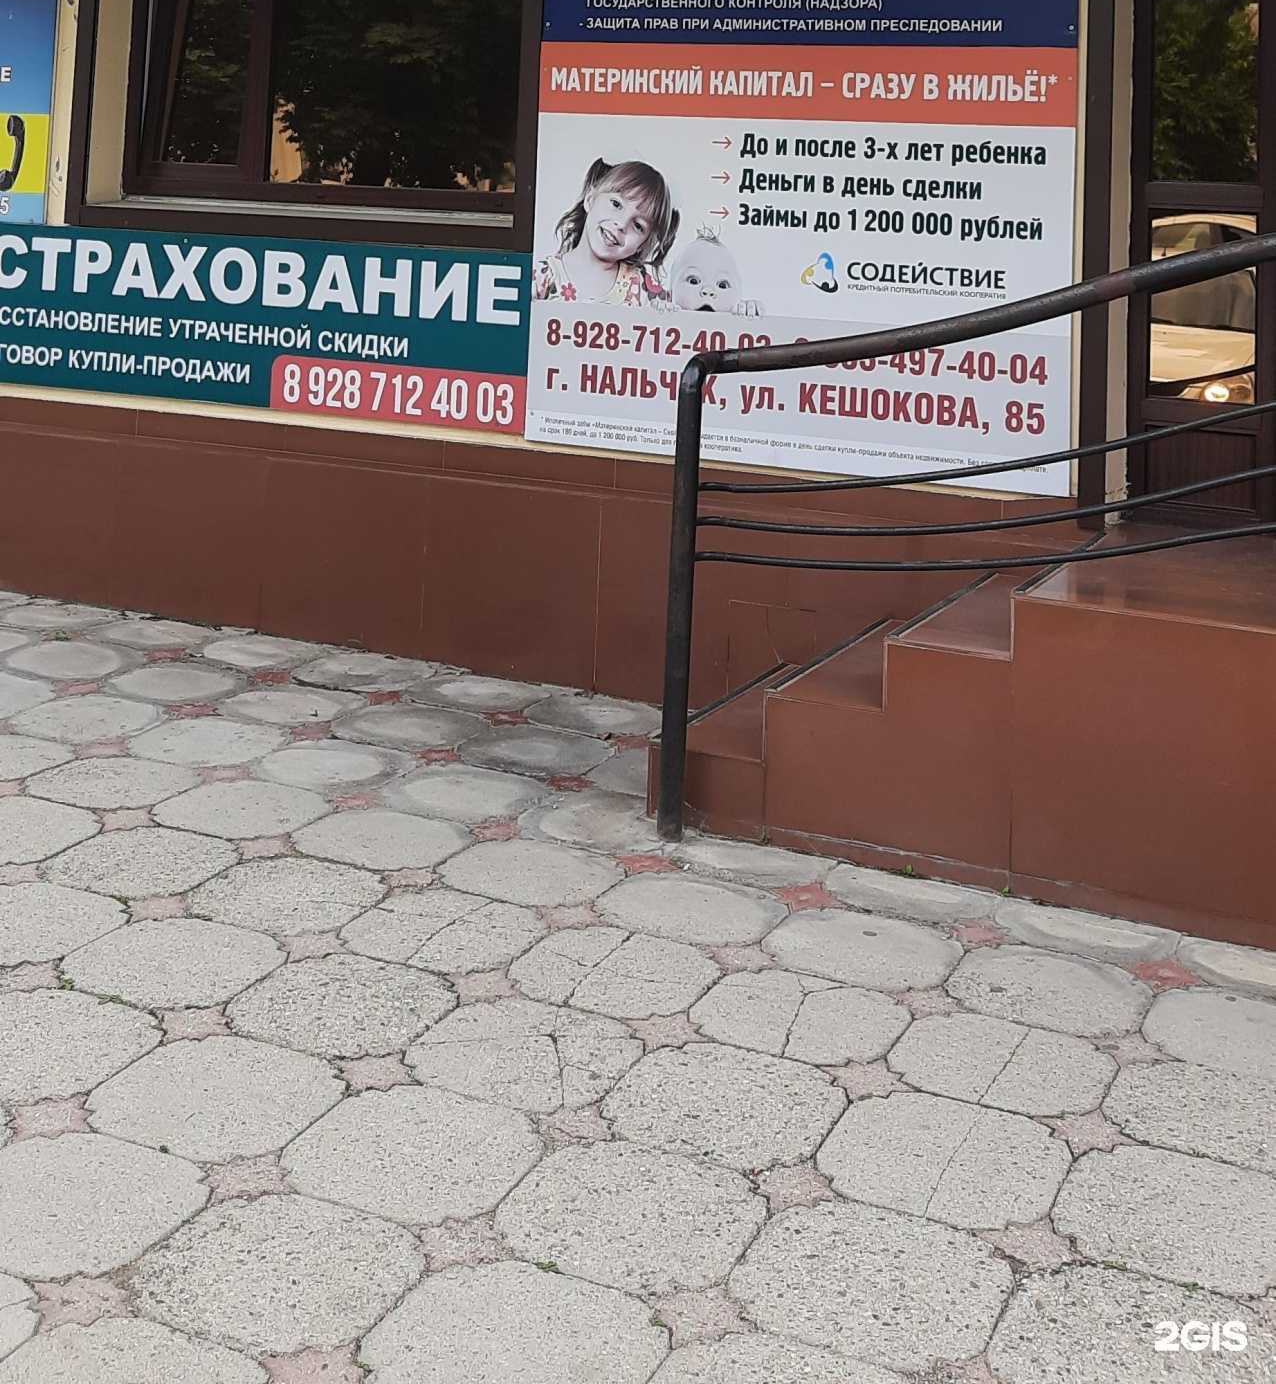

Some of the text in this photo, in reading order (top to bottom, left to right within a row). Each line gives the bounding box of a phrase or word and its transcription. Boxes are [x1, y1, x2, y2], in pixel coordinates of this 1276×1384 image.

[586, 18, 640, 31] ЗАЩИТА
[644, 18, 678, 30] ПРАВ
[682, 18, 709, 30] ПРИ
[713, 18, 866, 32] АДМИНИСТРАТИВНОМ
[870, 19, 1002, 33] ПРЕСЛЕДОВАНИИ
[551, 66, 703, 94] МАТЕРИНСКИЙ
[709, 70, 813, 97] КАПИТАЛ
[842, 73, 916, 100] СРАЗУ
[923, 74, 939, 100] В
[740, 134, 1046, 166] До и после 3-х лет ребенка
[738, 169, 982, 200] Деньги в день сделки
[738, 204, 1043, 241] Займы до 1 200 000 рублей
[0, 234, 522, 326] СТРАХОВАНИЕ
[846, 261, 1007, 289] СОДЕЙСТВИЕ
[848, 284, 1007, 299] КРЕДИТНЫЙ ПОТРЕБИТЕЛЬСКИЙ КООПЕРАТИВ
[169, 318, 311, 350] УТРАЧЕННОЙ
[318, 330, 409, 359] СКИДКИ
[68, 349, 250, 384] КУПЛИ-ПРОДАЖИ
[283, 364, 514, 426] 8 928 712 40 03
[547, 364, 1045, 435] г. НАЛЬЧК, ул. КЕШОКОВА, 85
